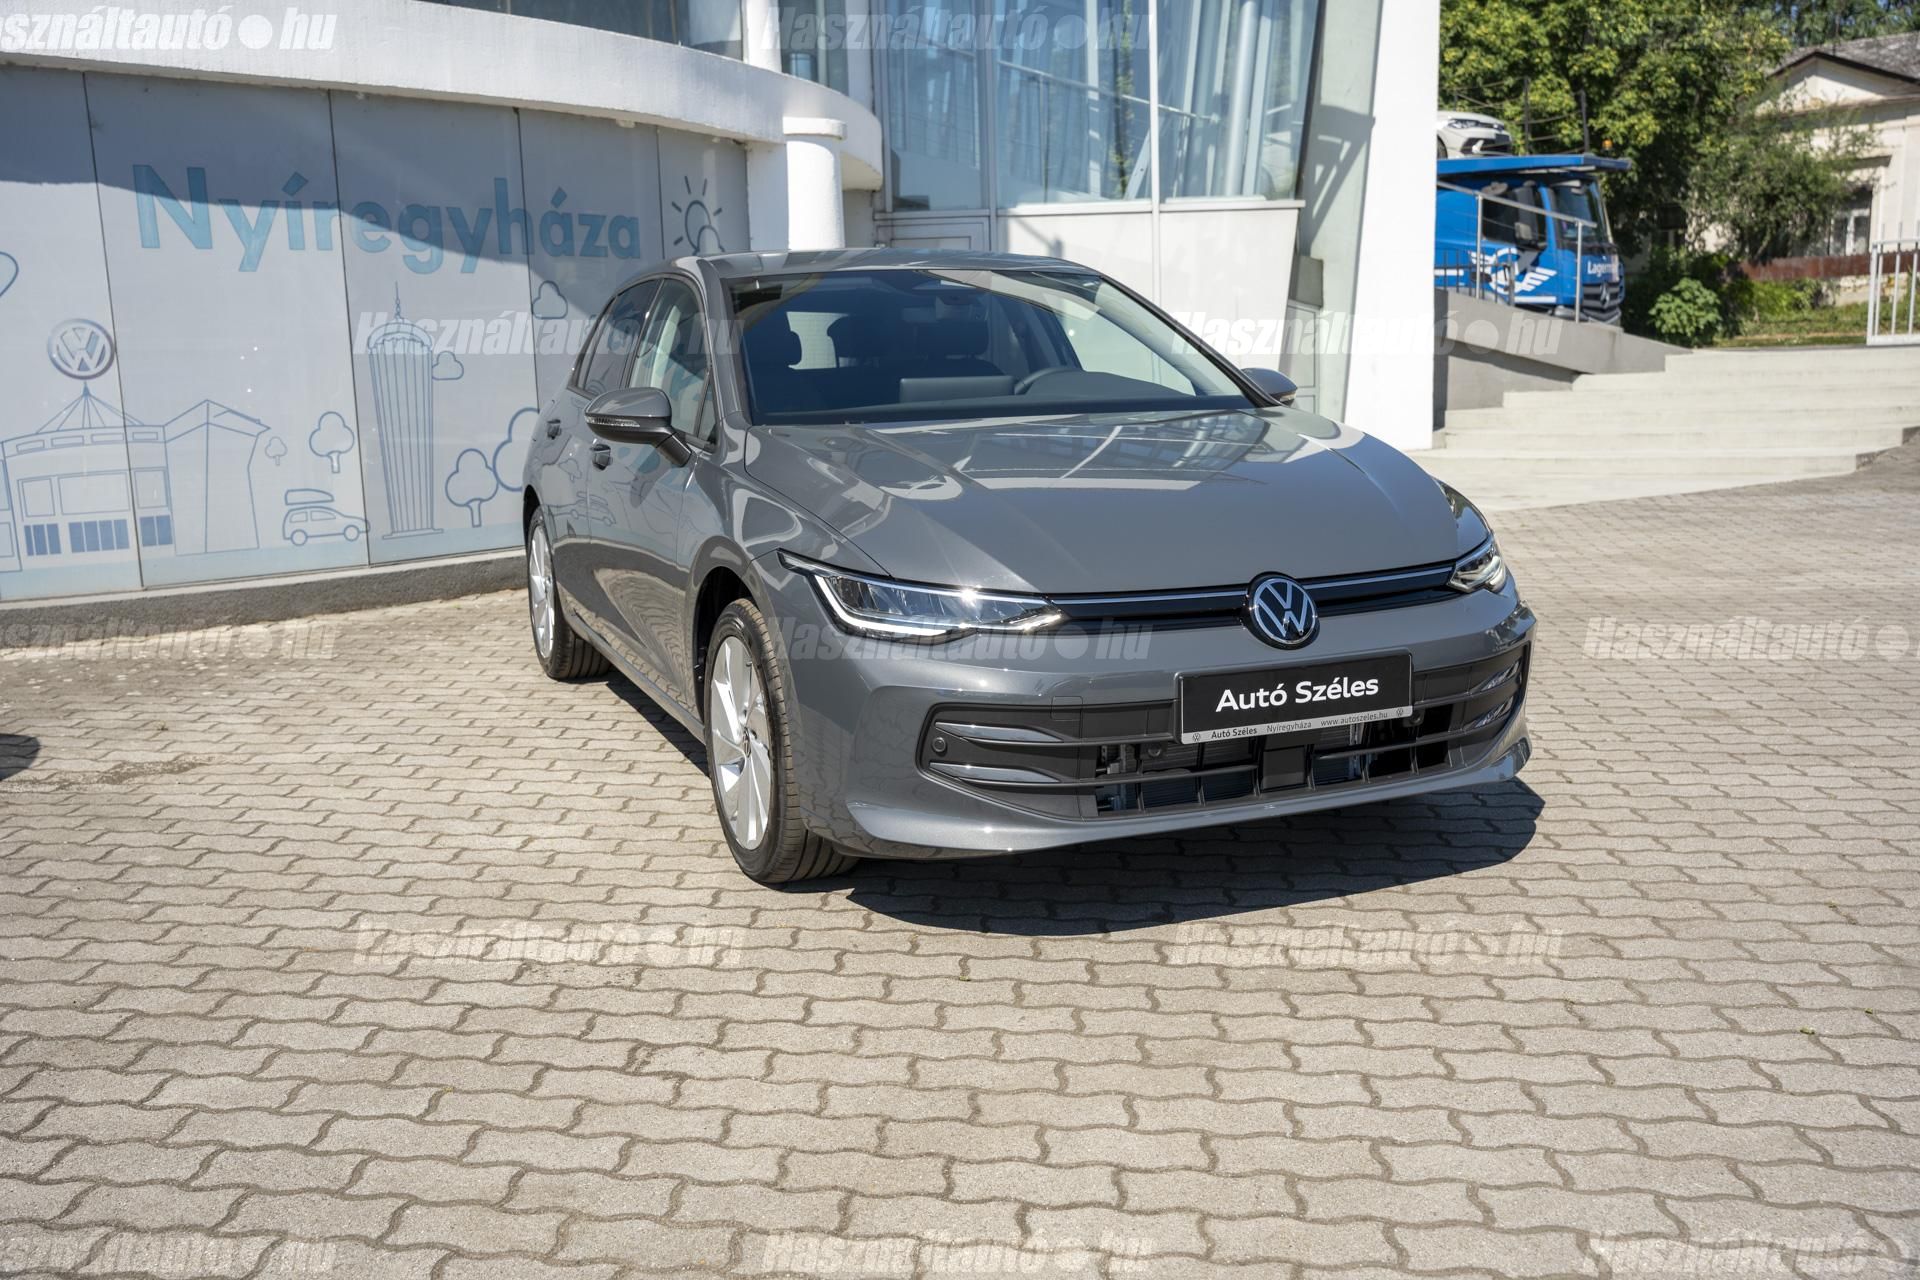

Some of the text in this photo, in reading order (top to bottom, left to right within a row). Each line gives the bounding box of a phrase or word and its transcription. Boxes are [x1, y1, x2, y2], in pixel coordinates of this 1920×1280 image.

[132, 163, 641, 274] Nyíregyháza
[1215, 676, 1379, 713] Autó Széles
[1266, 721, 1312, 733] Nyíregyháza
[1320, 711, 1388, 727] www.autoszeles.hu
[1211, 727, 1258, 740] Autó Széles
